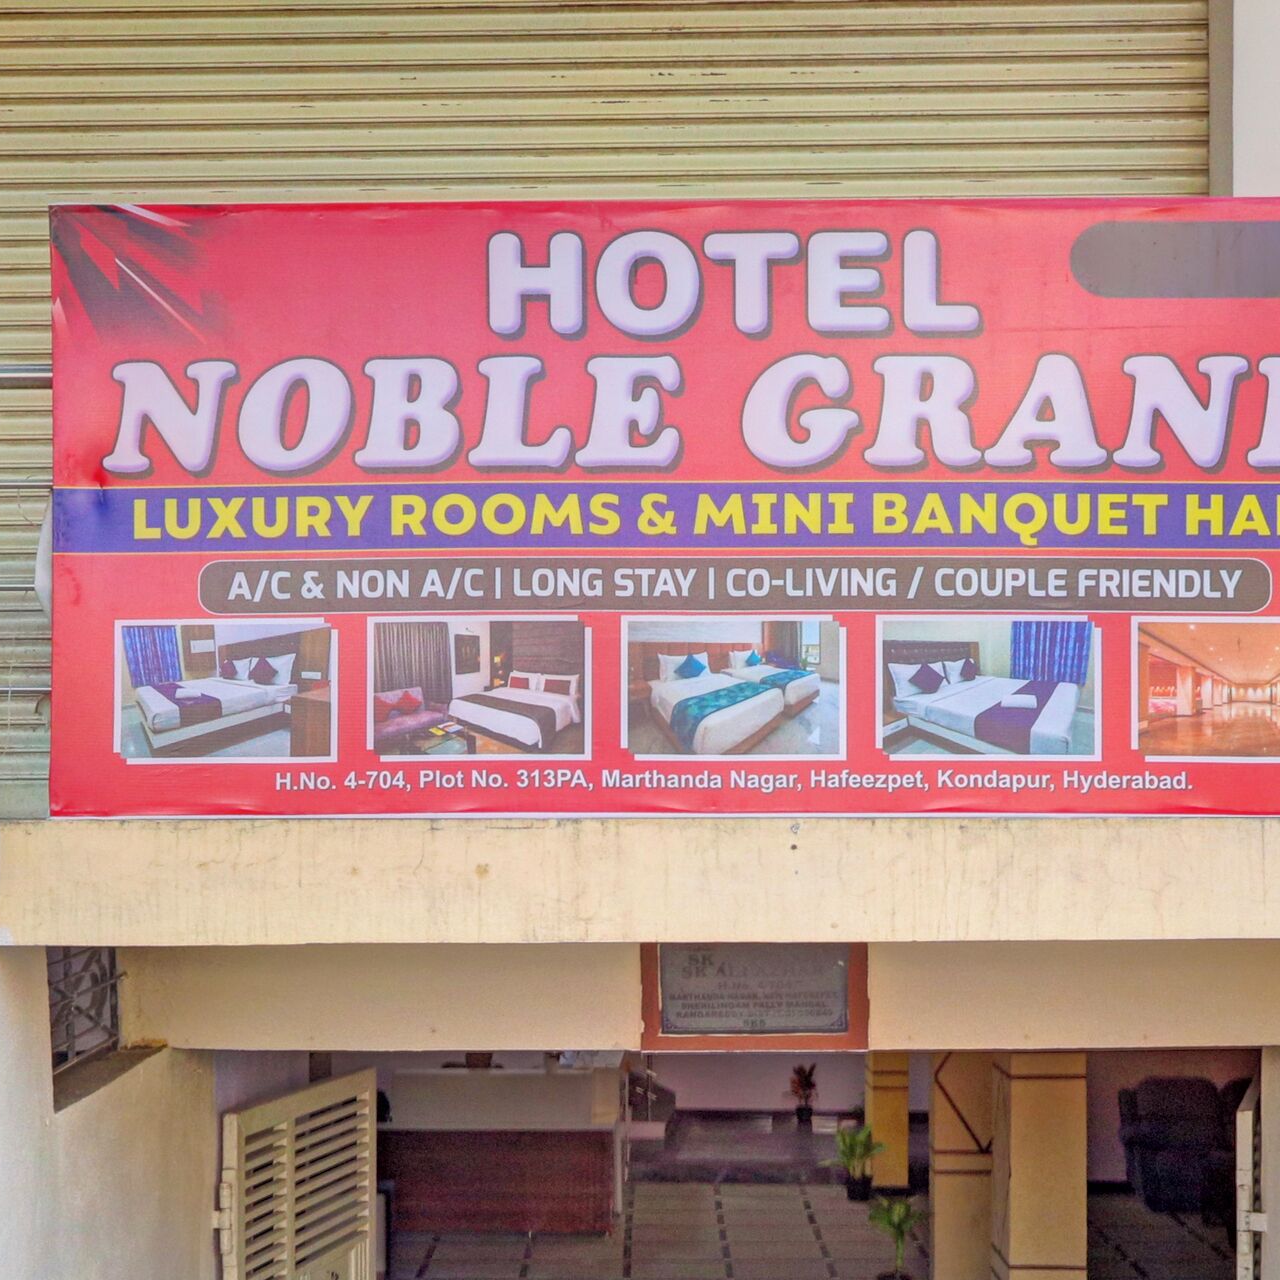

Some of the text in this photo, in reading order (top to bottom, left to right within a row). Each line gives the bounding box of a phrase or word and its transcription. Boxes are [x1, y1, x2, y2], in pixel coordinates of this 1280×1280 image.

[486, 229, 985, 340] HOTEL
[100, 354, 685, 476] NOBLE
[133, 495, 373, 540] LUXURY
[390, 493, 621, 537] ROOMS
[637, 493, 677, 535] &
[693, 492, 855, 535] MINI
[873, 492, 1168, 547] BANQUET
[227, 570, 291, 603] A/C
[300, 571, 324, 600] &
[336, 569, 410, 599] NON
[420, 567, 484, 600] A/C
[513, 567, 603, 597] LONG
[613, 567, 698, 598] STAY
[725, 567, 897, 597] CO-LIVING
[934, 567, 1068, 597] COUPLE
[1077, 568, 1243, 599] FRIENDLY
[275, 768, 1193, 793] H.No. 4-704, Plot No. 313PA, Marthanda Nagar, Hafeezpet, Kondapur, Hyderabad.
